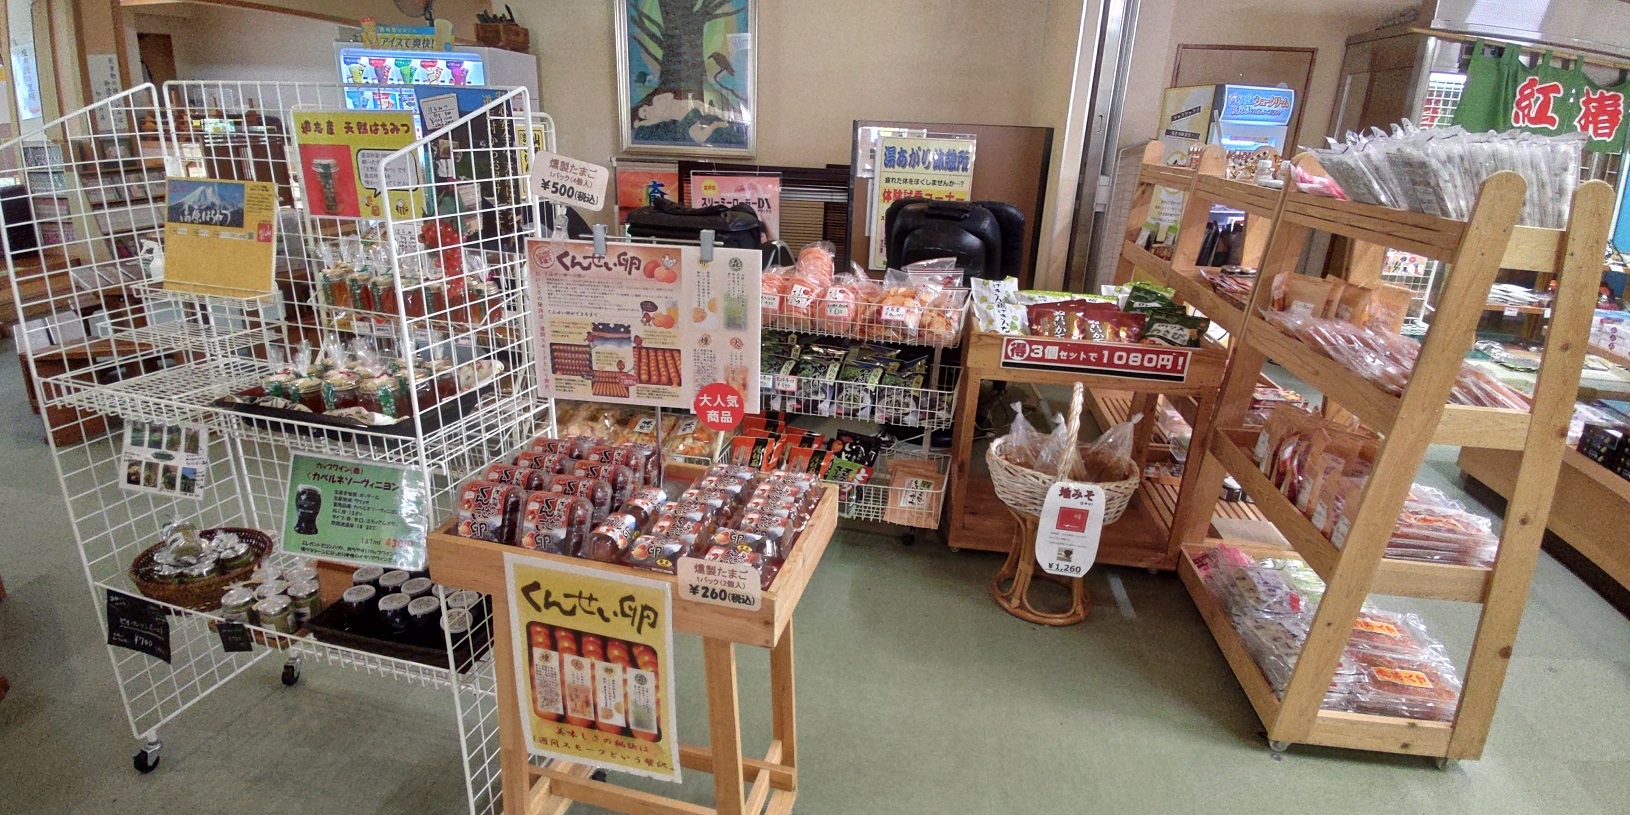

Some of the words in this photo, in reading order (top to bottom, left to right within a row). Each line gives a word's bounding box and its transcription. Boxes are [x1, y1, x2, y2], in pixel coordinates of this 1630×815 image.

[1512, 76, 1624, 142] 紅椿
[300, 119, 335, 135] 道志産
[343, 121, 411, 135] 天然はちみつ
[883, 145, 970, 172] 湯あがり休憩所
[548, 158, 598, 180] 燻製たまご
[556, 251, 642, 276] くんせい卵
[699, 394, 740, 408] 大人気
[706, 410, 733, 424] 商品
[1058, 486, 1095, 502] 地みそ
[694, 563, 748, 581] 燻製たまご
[696, 576, 746, 590] 1パック(2個入)
[521, 580, 658, 635] くんせい卵
